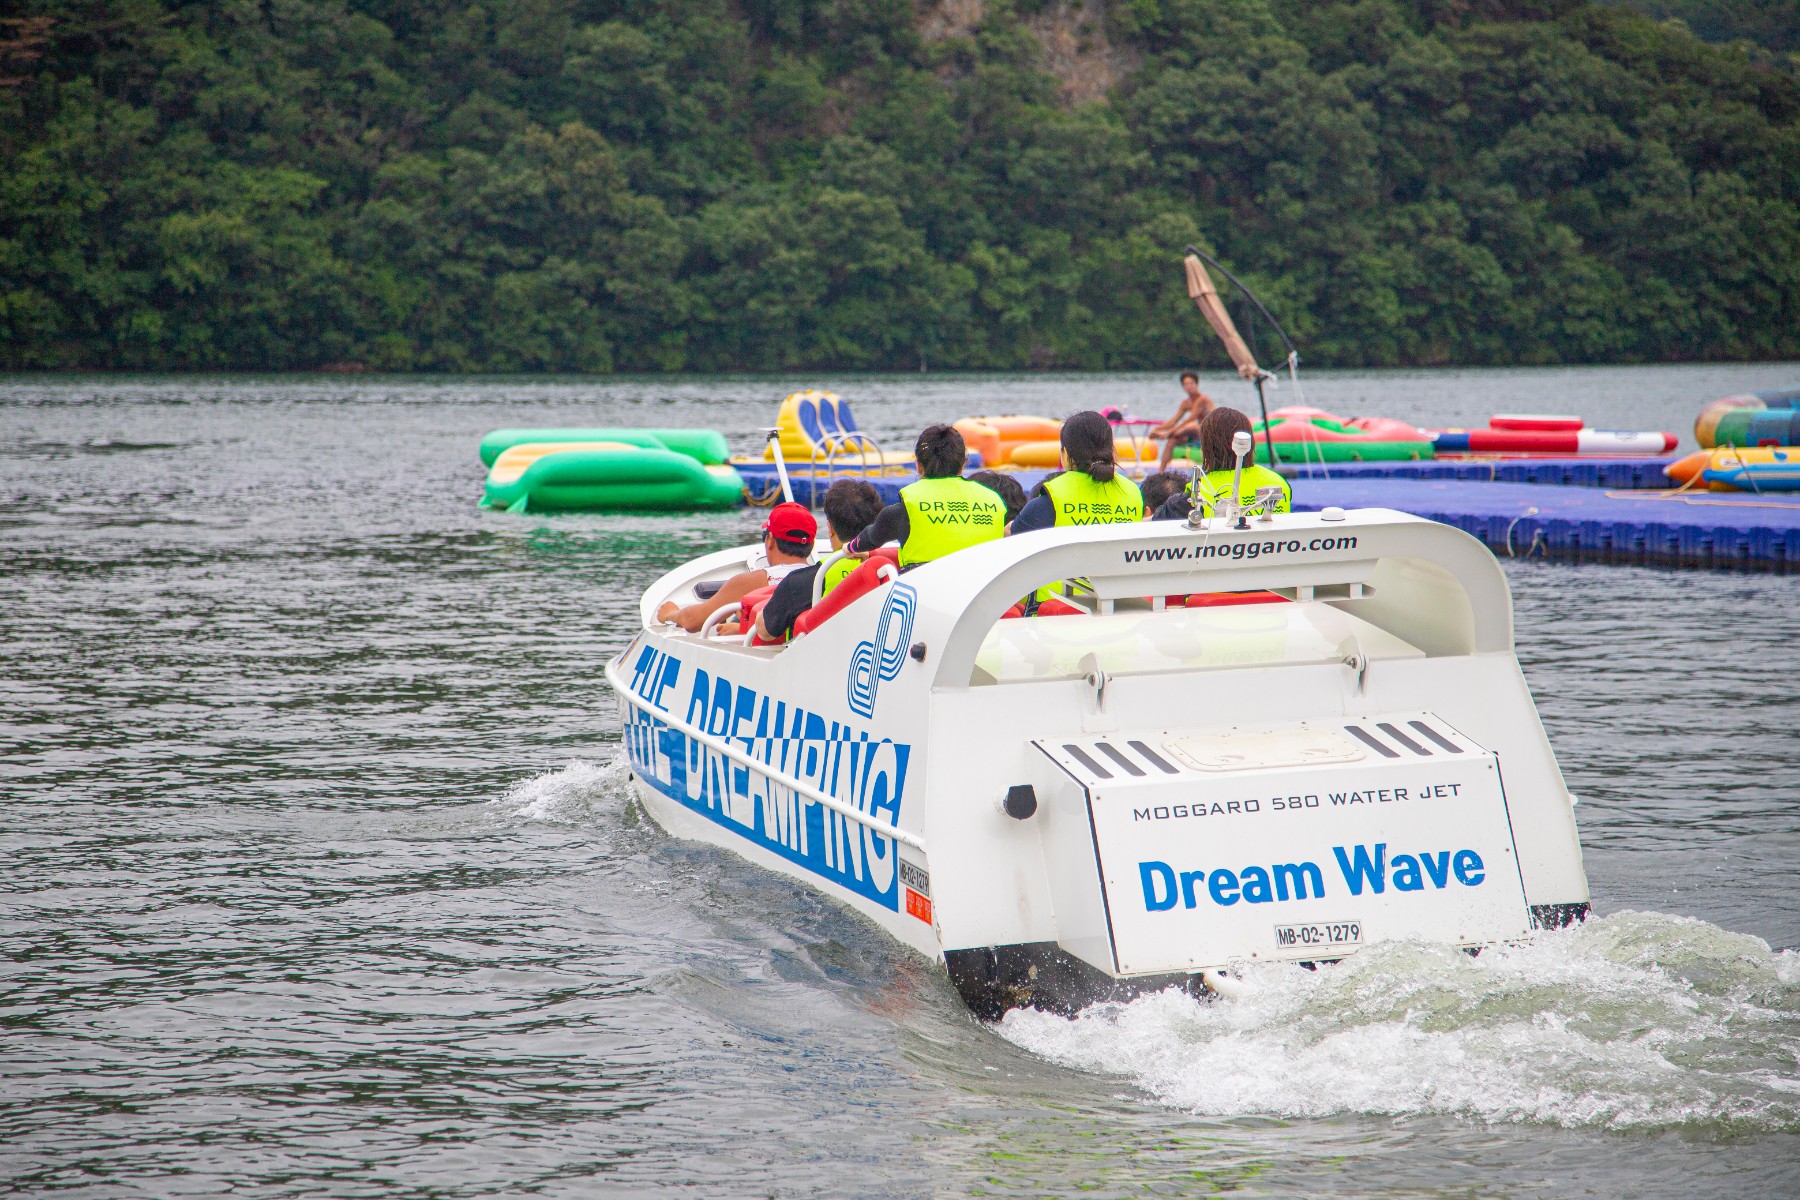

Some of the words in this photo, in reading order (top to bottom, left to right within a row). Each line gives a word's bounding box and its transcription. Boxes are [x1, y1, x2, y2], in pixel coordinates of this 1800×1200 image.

[919, 501, 997, 513] DREAM
[1063, 503, 1138, 517] DREAM
[1123, 536, 1358, 563] www.moggaro.com
[1133, 799, 1261, 822] MOGGARO
[1272, 794, 1320, 811] 580
[1328, 787, 1409, 806] WATER
[1419, 783, 1462, 799] JET
[1138, 859, 1326, 912] Dream
[1332, 842, 1487, 896] Wave
[1277, 923, 1360, 945] MB-02-1279
